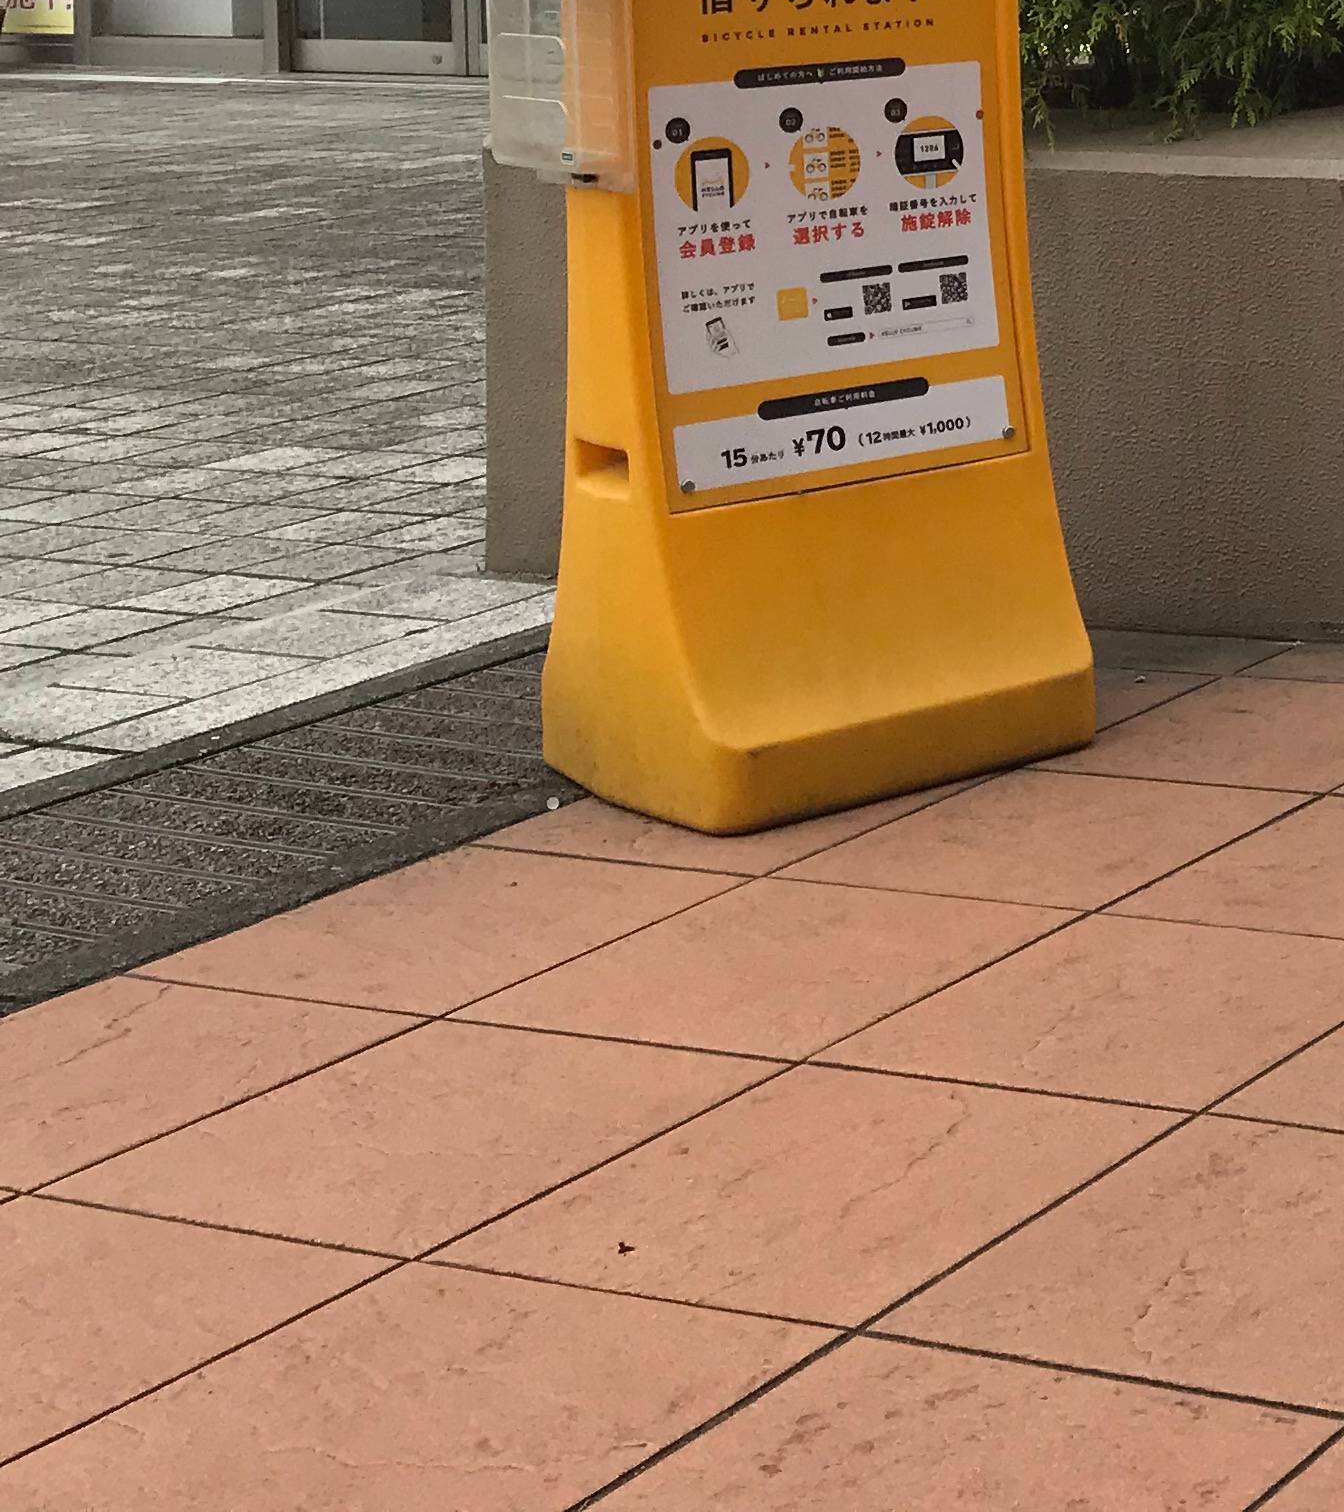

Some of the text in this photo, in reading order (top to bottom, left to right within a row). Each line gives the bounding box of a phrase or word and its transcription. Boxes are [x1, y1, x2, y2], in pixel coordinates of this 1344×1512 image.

[702, 18, 934, 43] BICYCLE RENTAL STATION
[787, 205, 868, 223] アプリで自転車を
[889, 193, 977, 211] 暗証番号を入力して
[678, 219, 751, 236] アプリを使って
[901, 208, 972, 232] 施錠解除
[793, 221, 865, 245] 選択する
[679, 233, 756, 259] 会員登録
[792, 425, 847, 457] ¥70
